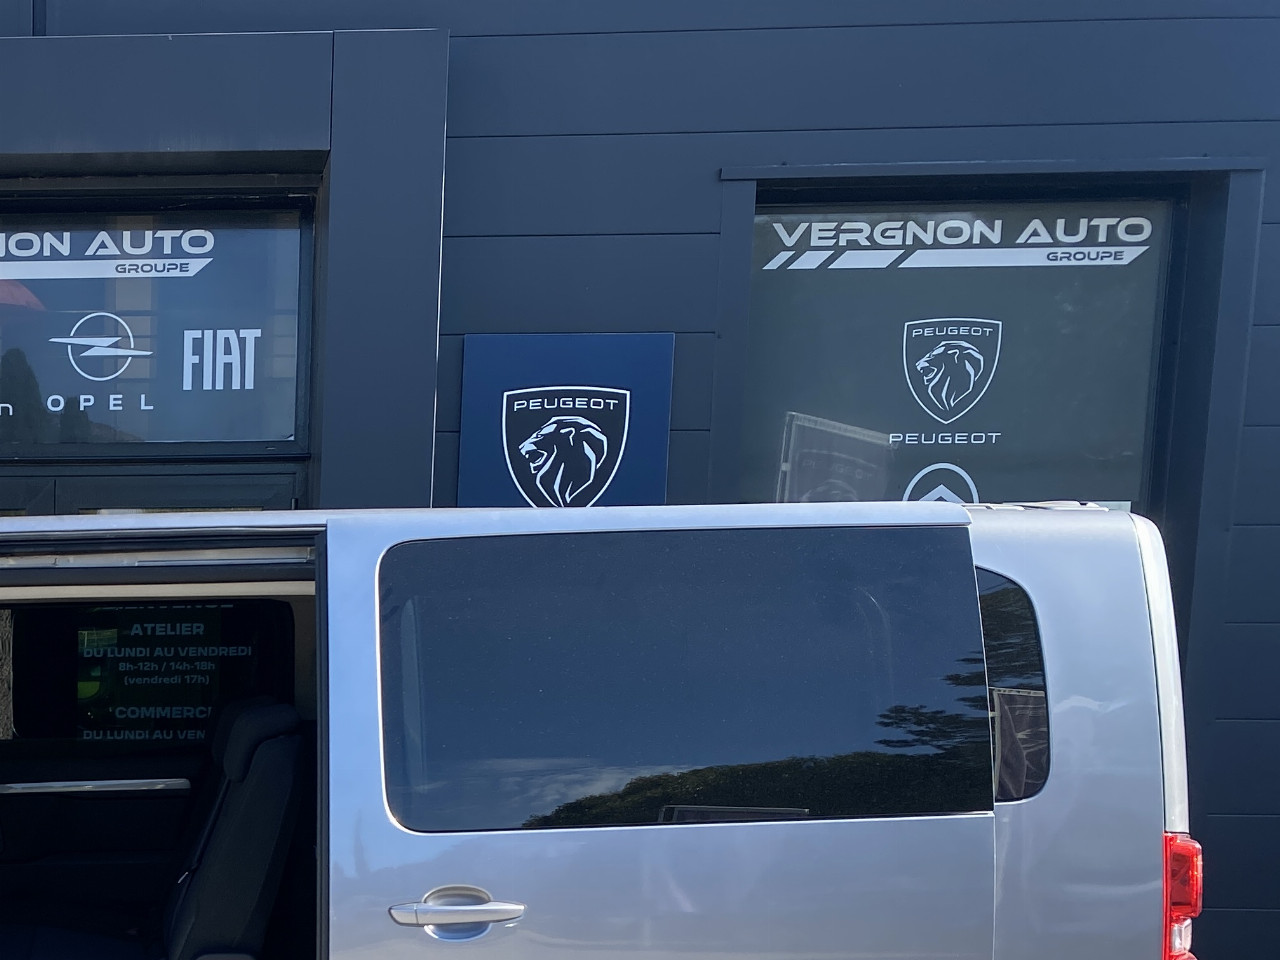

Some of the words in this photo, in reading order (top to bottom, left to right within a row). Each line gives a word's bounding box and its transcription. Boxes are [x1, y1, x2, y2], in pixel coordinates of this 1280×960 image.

[772, 219, 1003, 247] VERGNON
[1015, 217, 1153, 244] AUTO
[84, 229, 215, 256] AUTO
[1046, 250, 1126, 262] GROUPE
[114, 261, 190, 274] GROUPE
[912, 326, 994, 338] PEUGEOT
[182, 328, 262, 391] FIAT
[46, 393, 154, 412] OPEL
[513, 397, 620, 412] PEUGEOT
[888, 432, 1002, 445] PEUGEOT
[130, 623, 205, 636] ATELIER
[83, 647, 103, 658] DU
[107, 647, 150, 657] LUNDI
[153, 647, 175, 657] AU
[177, 646, 252, 657] VENDREDI
[118, 662, 159, 671] 8h-12h
[169, 661, 216, 671] 14h-18h
[124, 675, 182, 685] (vendredi
[184, 674, 210, 685] 17h)
[83, 730, 103, 740] DU
[106, 730, 149, 740] LUNDI
[152, 730, 174, 740] AU
